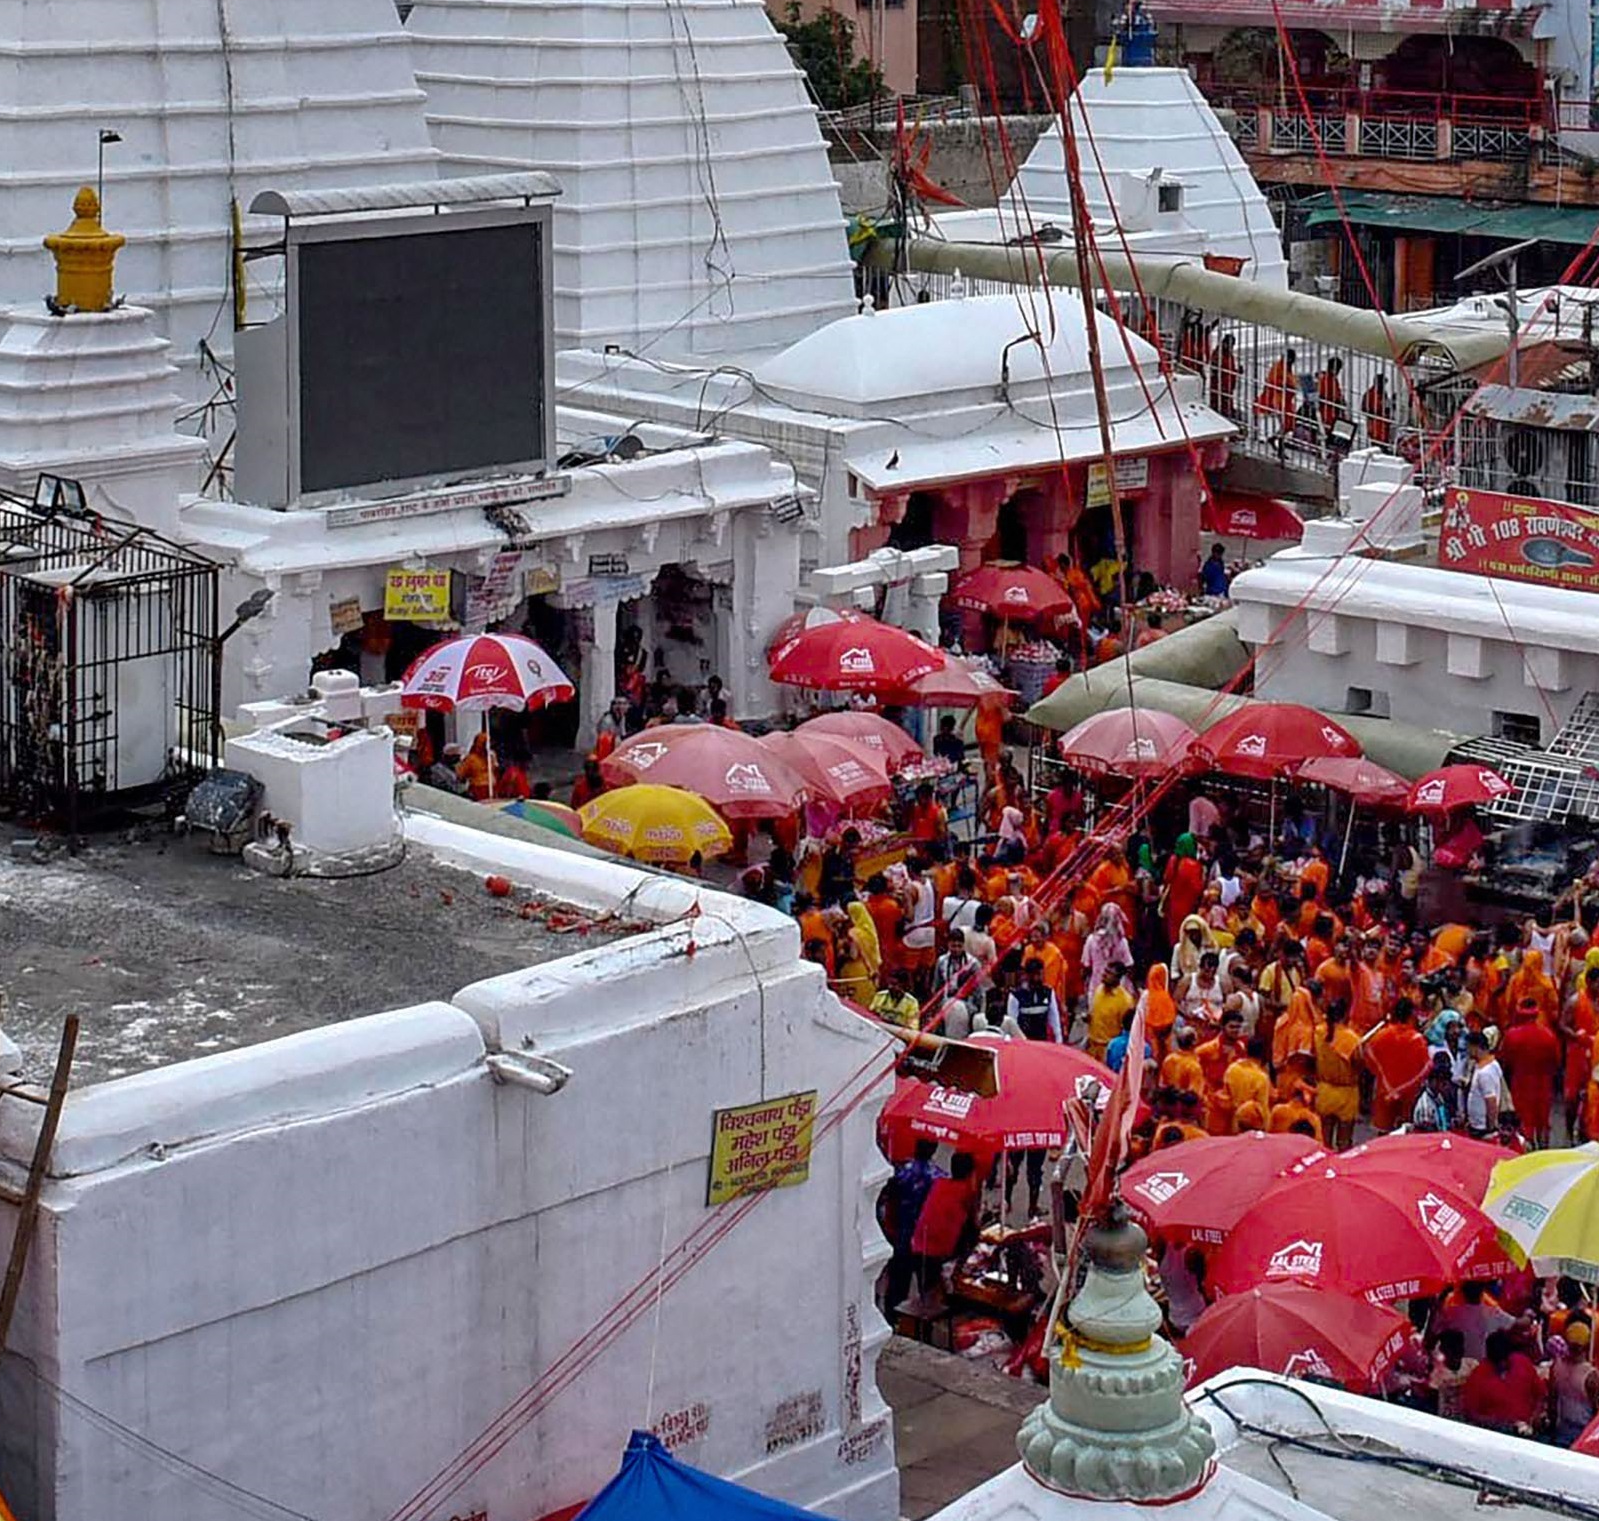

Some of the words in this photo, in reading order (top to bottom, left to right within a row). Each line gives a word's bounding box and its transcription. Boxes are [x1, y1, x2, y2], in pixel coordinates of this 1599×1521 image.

[1491, 517, 1520, 541] 108
[720, 1107, 785, 1133] विश्वनाथ
[731, 1130, 769, 1151] महेश
[724, 1150, 770, 1174] अनिल
[1269, 1255, 1289, 1267] LAL
[1291, 1255, 1321, 1270] STEEL
